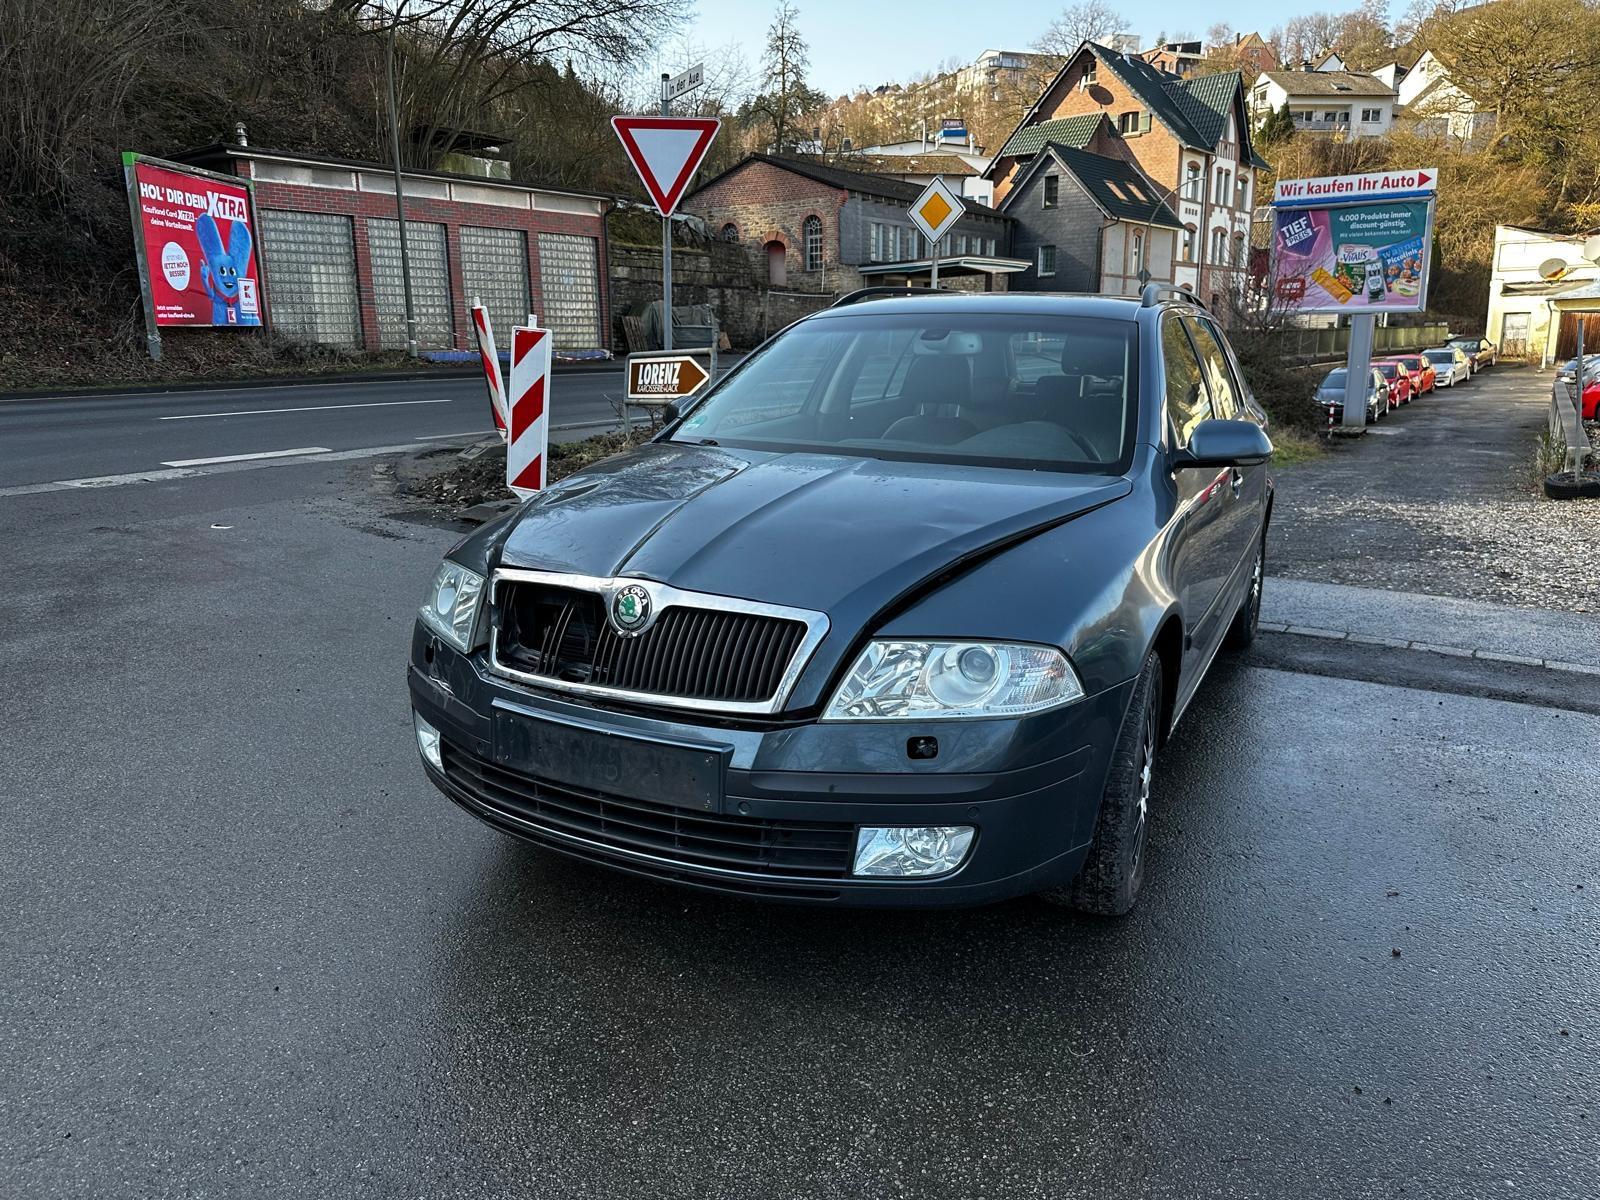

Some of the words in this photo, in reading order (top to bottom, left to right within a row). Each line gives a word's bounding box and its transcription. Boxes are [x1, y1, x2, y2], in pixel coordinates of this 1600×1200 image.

[669, 83, 674, 96] In
[677, 79, 686, 92] der
[689, 72, 699, 86] Aue
[1280, 184, 1303, 196] Wir
[1307, 180, 1353, 195] kaufen
[1358, 178, 1378, 191] Ihr
[1381, 176, 1415, 189] Auto
[140, 183, 165, 201] HOL'
[166, 188, 184, 205] DIR
[185, 192, 207, 209] DEIN
[206, 191, 247, 222] XTRA
[143, 205, 165, 215] Kaufland
[166, 210, 177, 218] Card
[178, 210, 194, 222] XTRA
[151, 218, 164, 227] deine
[165, 220, 194, 231] Vorteilswelt.
[1281, 216, 1308, 238] TIEF
[1350, 220, 1406, 230] discount-günstig.
[1286, 228, 1312, 245] PREIS
[638, 362, 682, 385] LORENZ
